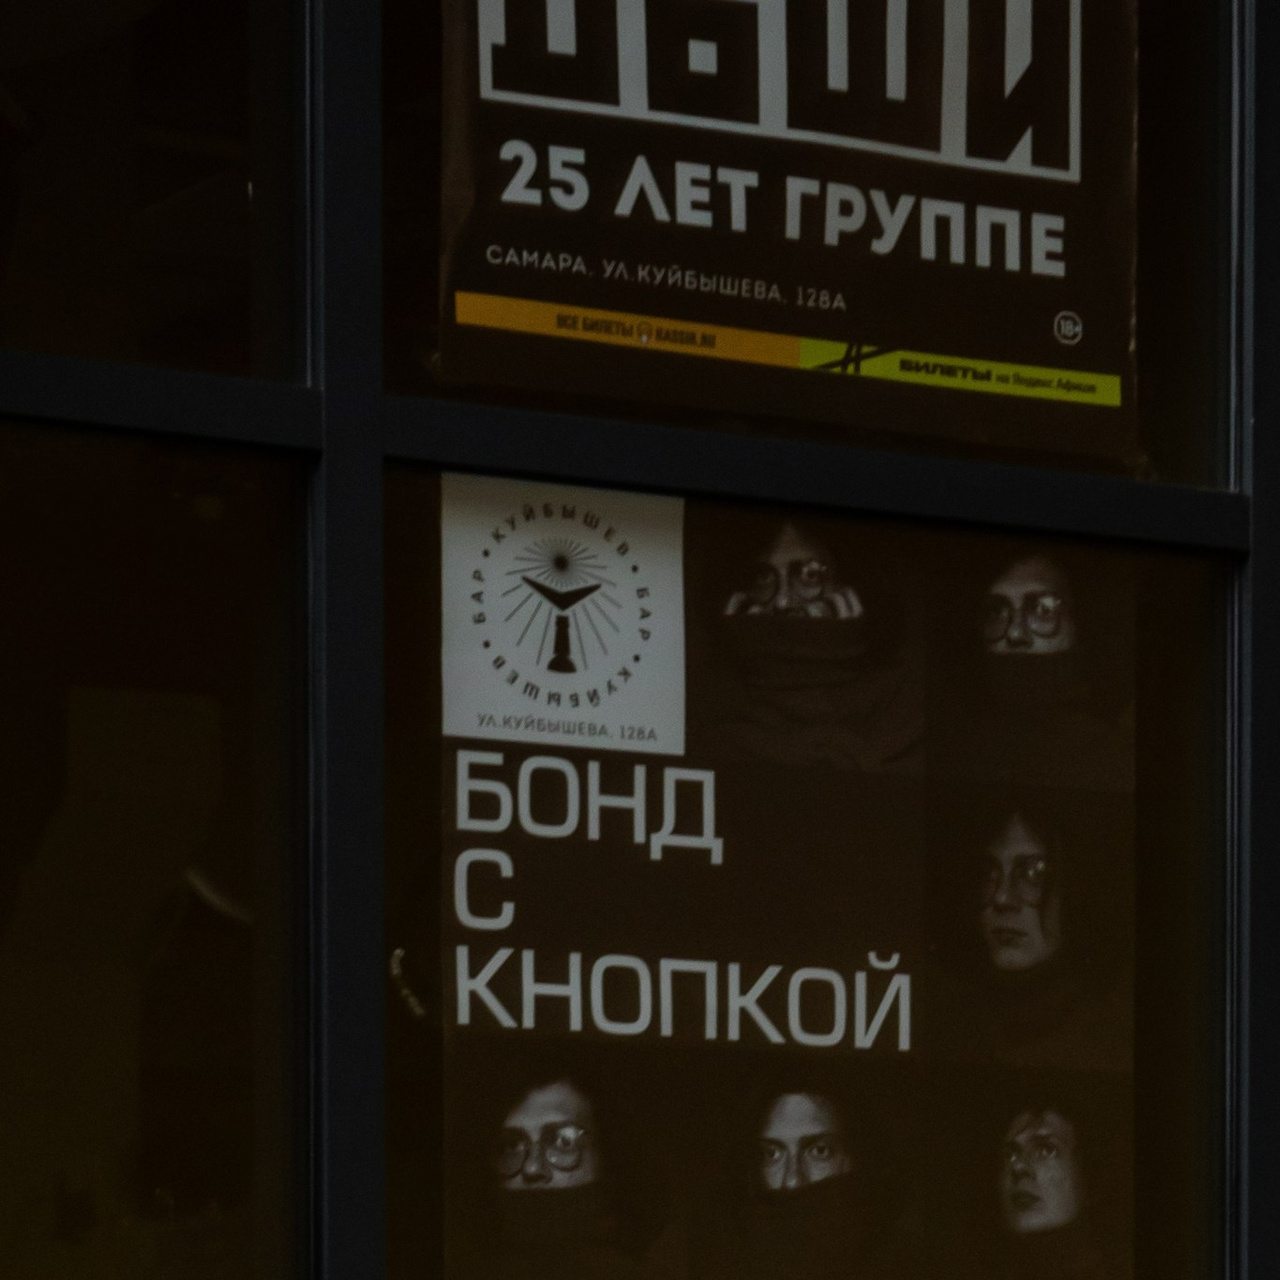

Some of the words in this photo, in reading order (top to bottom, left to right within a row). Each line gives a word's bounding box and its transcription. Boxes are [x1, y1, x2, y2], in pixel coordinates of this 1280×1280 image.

[499, 138, 591, 212] 25
[613, 153, 760, 233] ЛЕТ
[784, 174, 1067, 279] ГРУППЕ
[900, 358, 992, 382] БИЛЕТЫ
[455, 748, 724, 866] БОНД
[453, 847, 516, 931] С
[455, 944, 912, 1052] КНОПКОЙ
